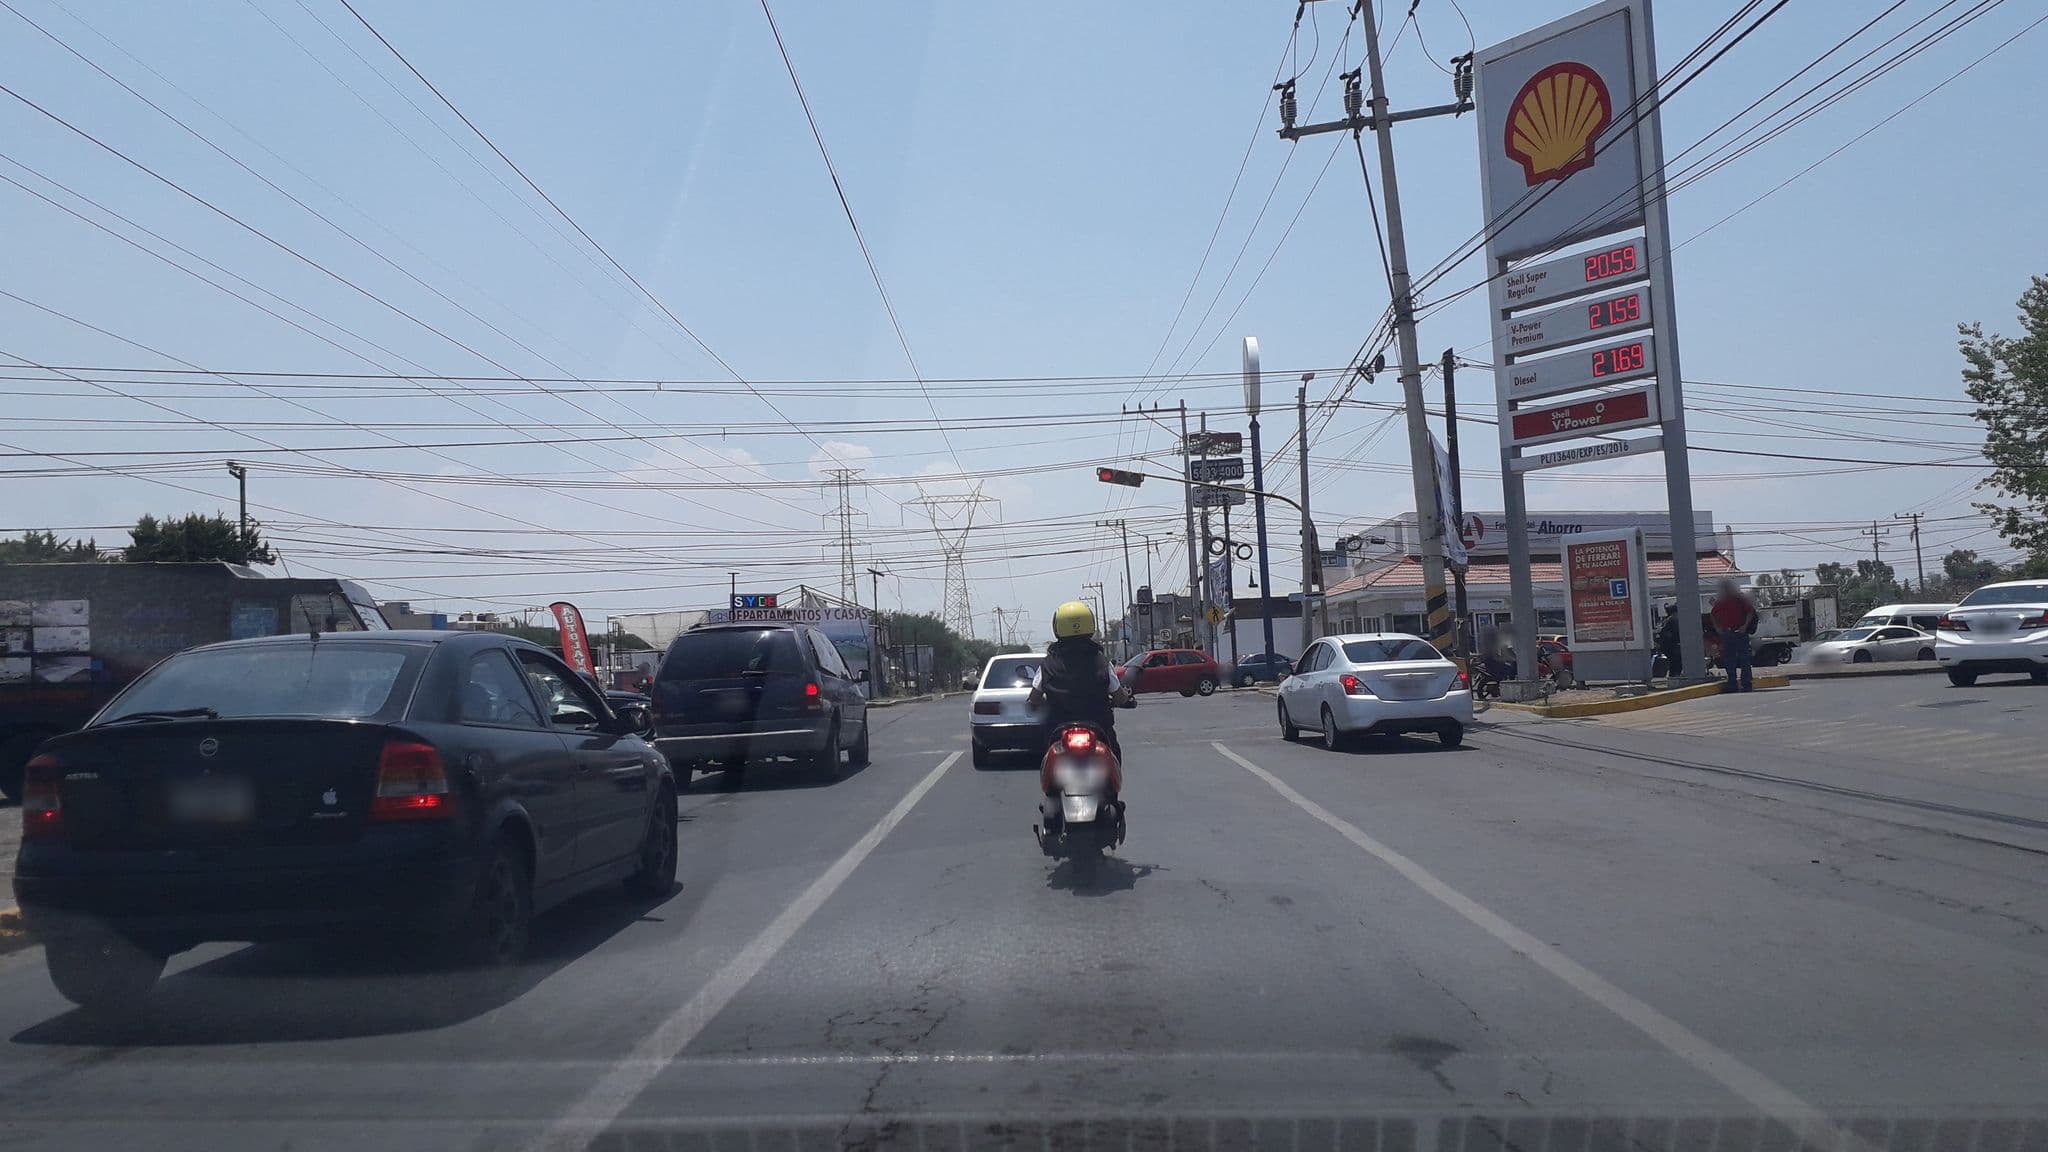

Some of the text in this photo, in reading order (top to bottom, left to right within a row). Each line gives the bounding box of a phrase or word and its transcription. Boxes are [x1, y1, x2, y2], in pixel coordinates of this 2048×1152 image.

[1586, 247, 1636, 282] 20.59
[1507, 270, 1547, 288] Shell Super
[1507, 285, 1536, 299] Regular
[1590, 295, 1639, 329] 21.59
[1511, 321, 1542, 334] V-Power
[1511, 332, 1544, 346] Premium
[1593, 344, 1644, 377] 21.69
[1514, 373, 1537, 386] Diesel
[1552, 409, 1570, 420] Shell
[1552, 415, 1602, 431] V-Power
[1538, 521, 1582, 534] Ahorro
[1575, 544, 1620, 556] LA POTENCIA
[1575, 552, 1621, 563] DE FERRARI
[1591, 560, 1621, 568] ALCANCE
[1616, 583, 1623, 594] E
[729, 608, 869, 621] DEPARTAMENTOS Y CASAS
